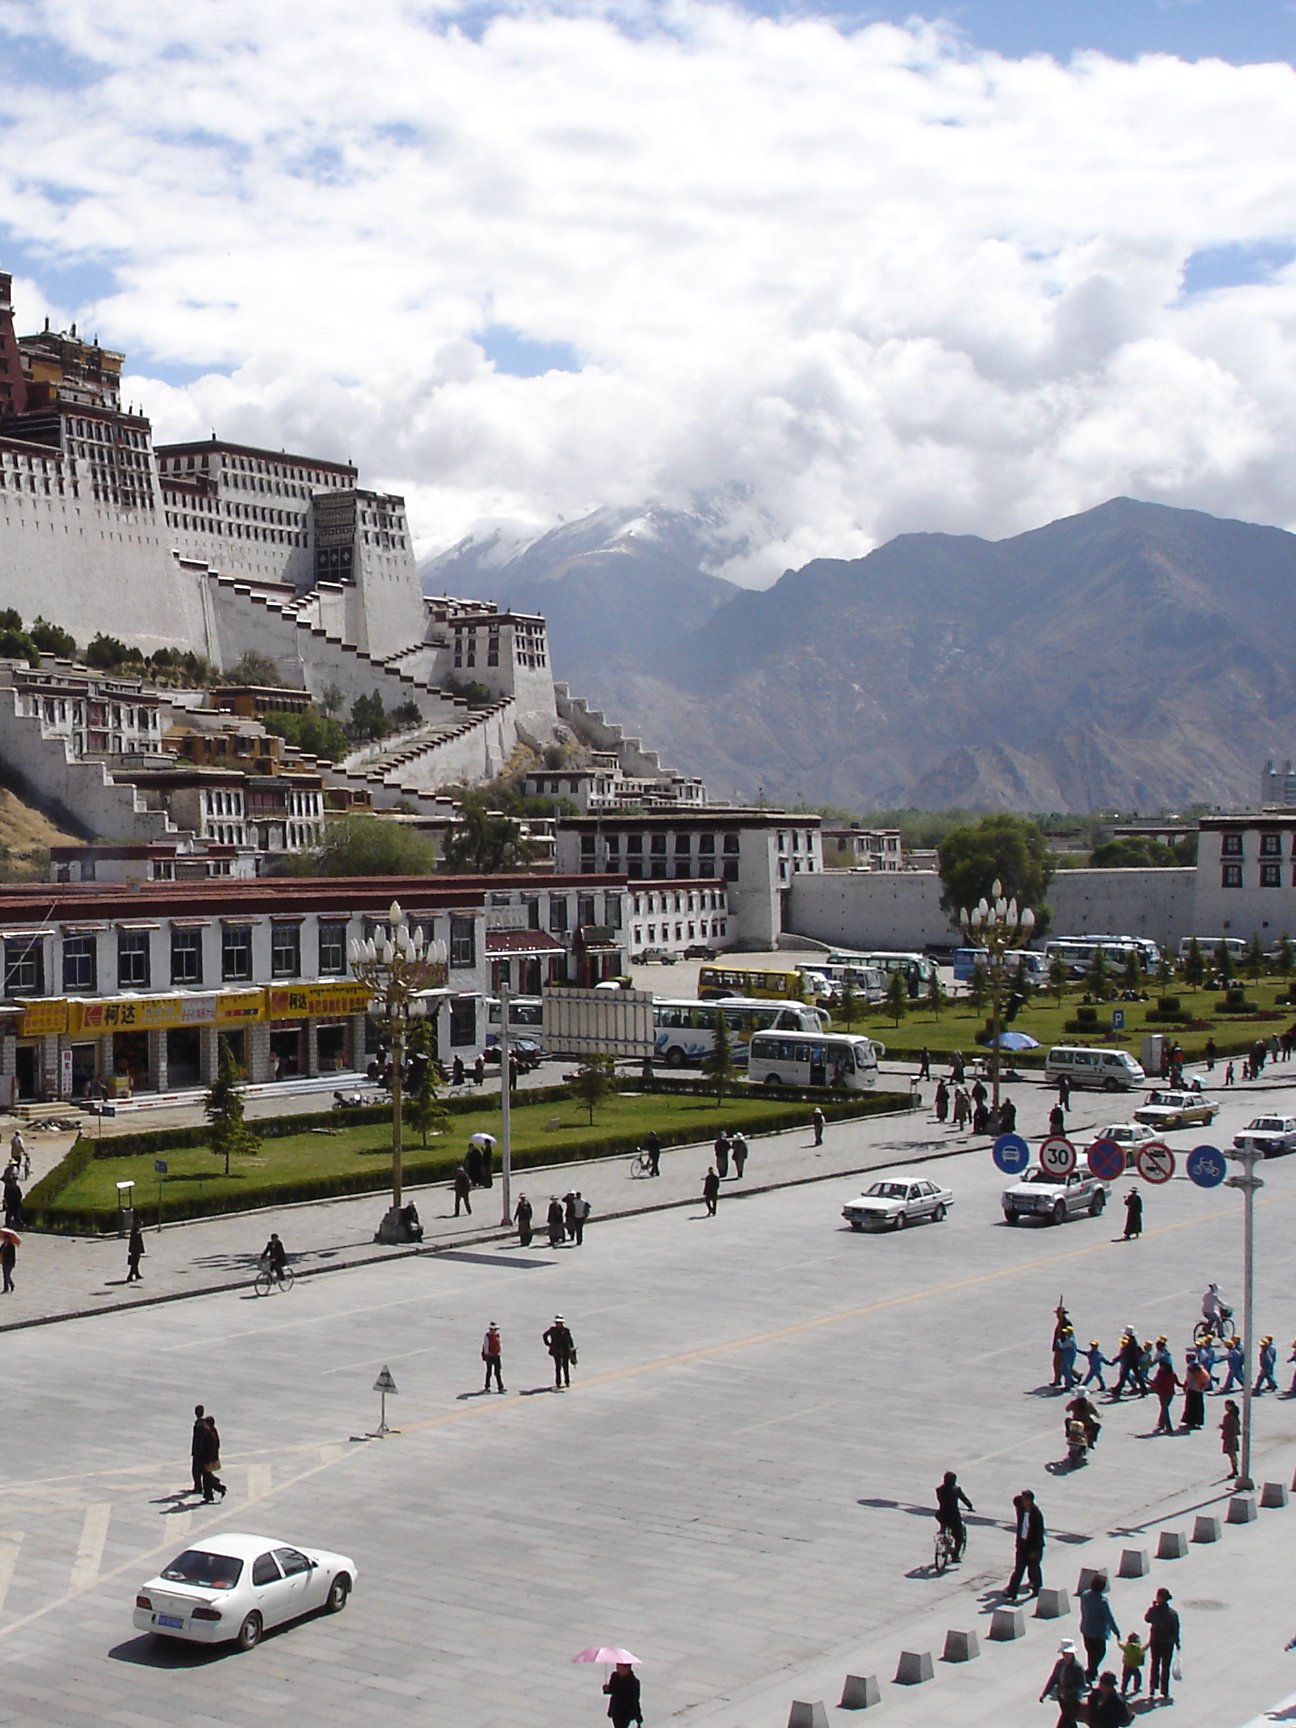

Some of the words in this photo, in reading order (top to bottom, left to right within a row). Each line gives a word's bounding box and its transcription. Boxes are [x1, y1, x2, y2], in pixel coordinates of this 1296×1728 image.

[289, 992, 307, 1010] 柯达
[104, 1004, 136, 1026] 柯达
[1115, 1012, 1122, 1026] P
[1047, 1148, 1069, 1166] 30
